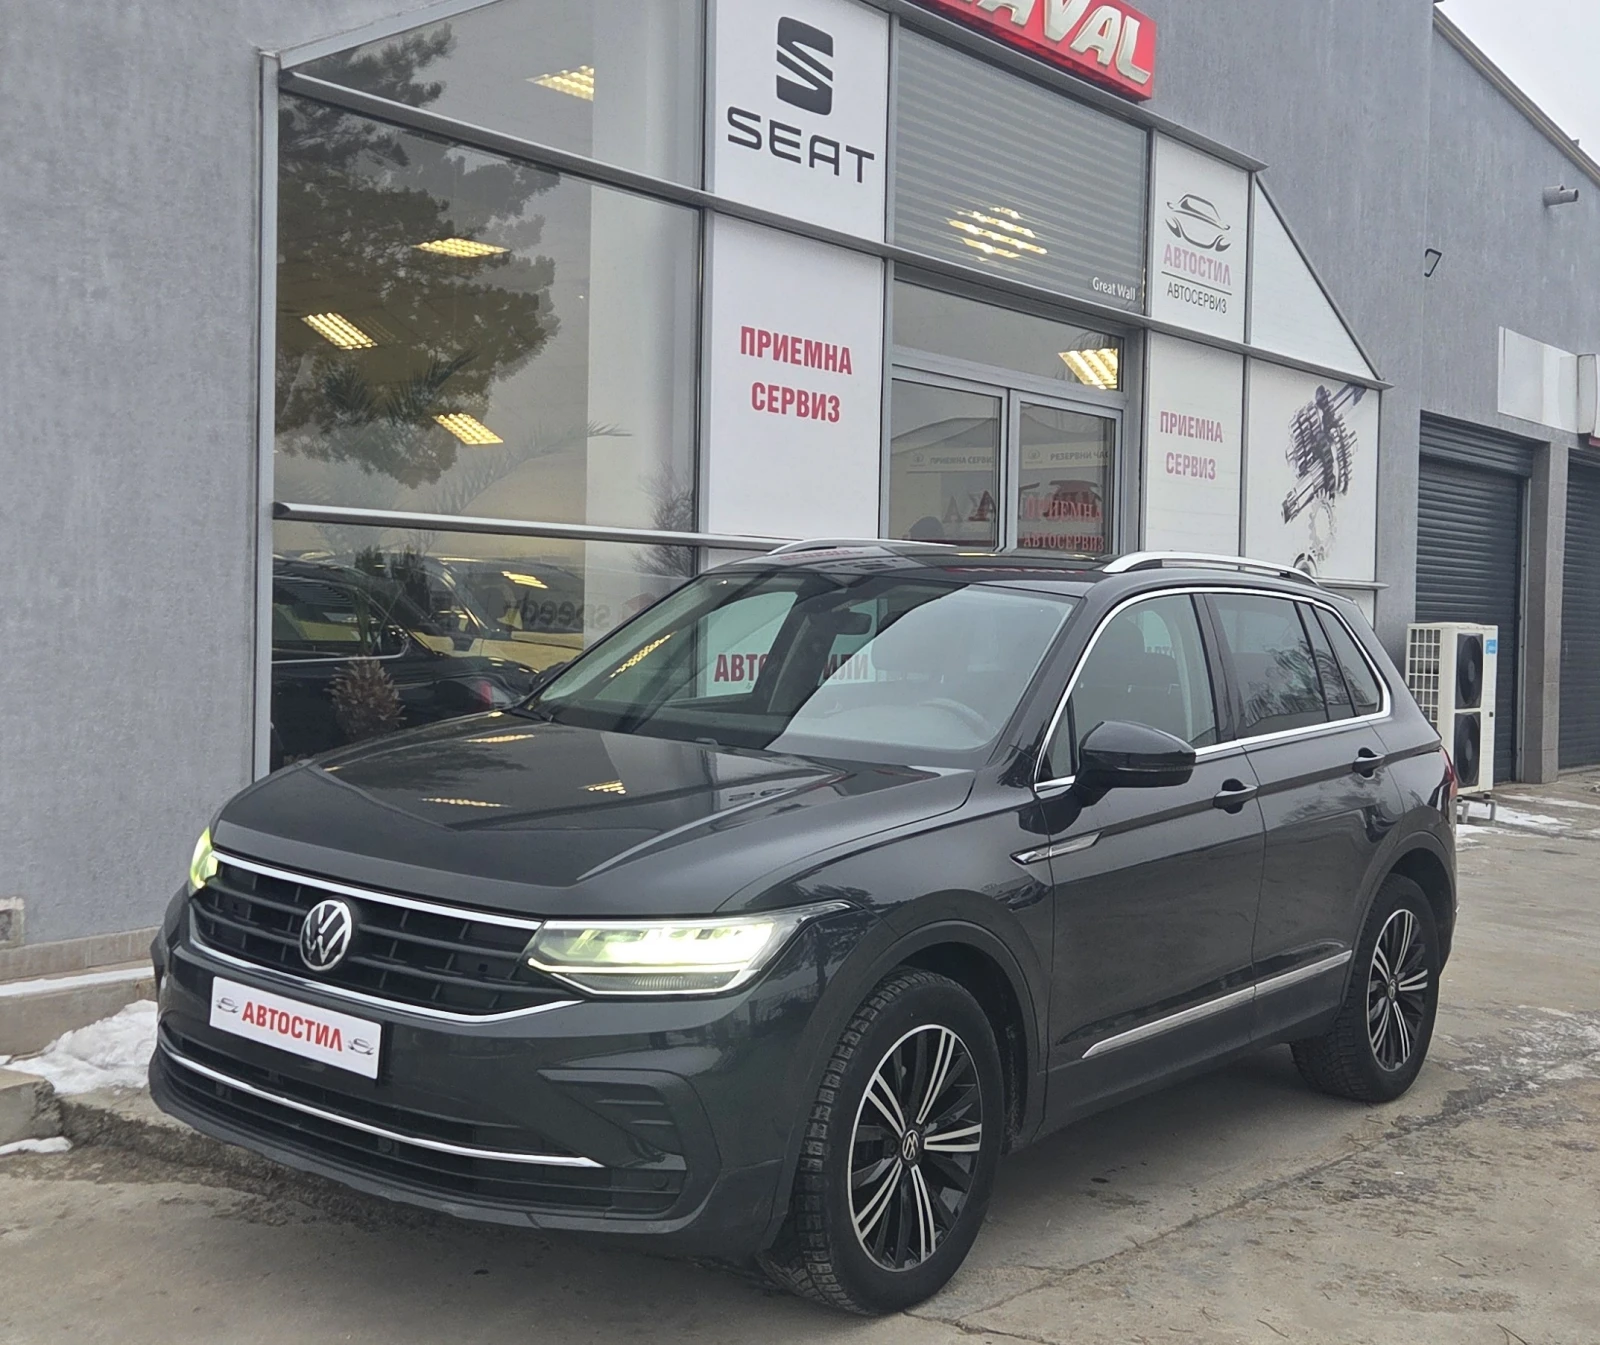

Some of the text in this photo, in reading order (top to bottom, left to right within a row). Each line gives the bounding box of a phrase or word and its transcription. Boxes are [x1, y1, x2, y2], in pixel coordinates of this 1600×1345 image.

[727, 106, 875, 184] SEAT
[1163, 243, 1232, 286] АВТОСТИЛ
[1092, 276, 1136, 301] Great Wall
[1166, 281, 1227, 314] АВТОСЕРВИЗ
[740, 325, 852, 375] ПРИЕМНА
[751, 381, 841, 423] СЕРВИЗ
[1160, 410, 1223, 444] ПРИЕМНА
[1165, 451, 1217, 481] СЕРВИЗ
[1023, 533, 1104, 552] АВТОСЕРВИЗ
[241, 1001, 343, 1053] АВТОСТИЛ
